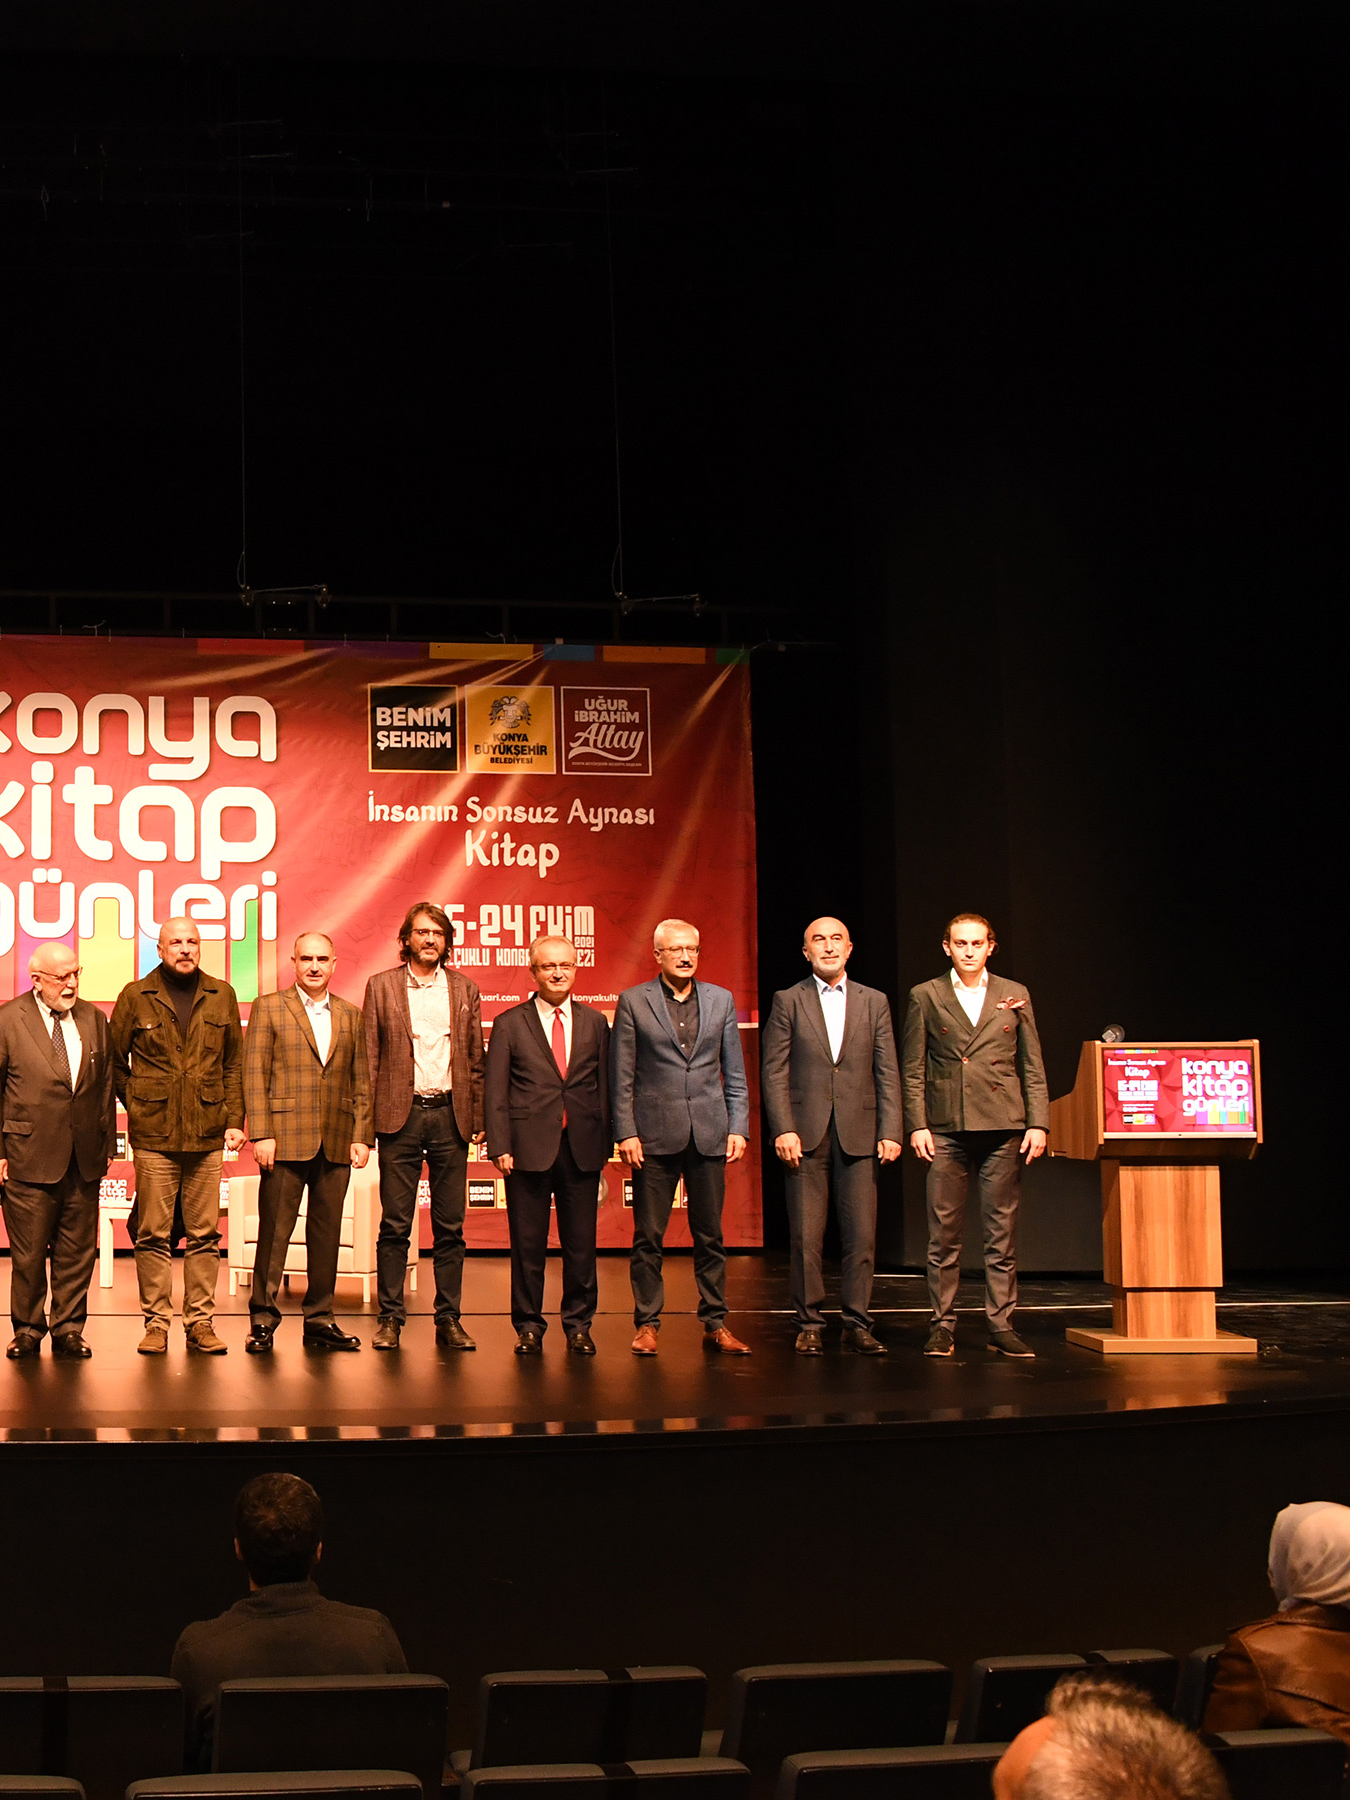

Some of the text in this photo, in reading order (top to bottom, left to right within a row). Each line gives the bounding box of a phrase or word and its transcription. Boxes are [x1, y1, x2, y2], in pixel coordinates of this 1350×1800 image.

[584, 695, 628, 711] UĞUR
[493, 732, 529, 742] KONYA
[568, 722, 645, 761] Altay
[473, 742, 548, 757] BÜYÜKŞEHİR
[490, 756, 533, 764] BELEDİYESİ
[368, 790, 655, 832] İnsanın Sonsuz Aynası
[464, 829, 560, 878] Kitap
[434, 903, 524, 946] 5-24
[574, 936, 595, 948] 2021
[444, 947, 490, 969] LÇUKLU
[576, 949, 595, 967] EZİ
[479, 993, 520, 1002] uari.com
[1181, 1057, 1249, 1079] konya
[1182, 1075, 1249, 1100] kitap
[1182, 1096, 1249, 1116] günleri
